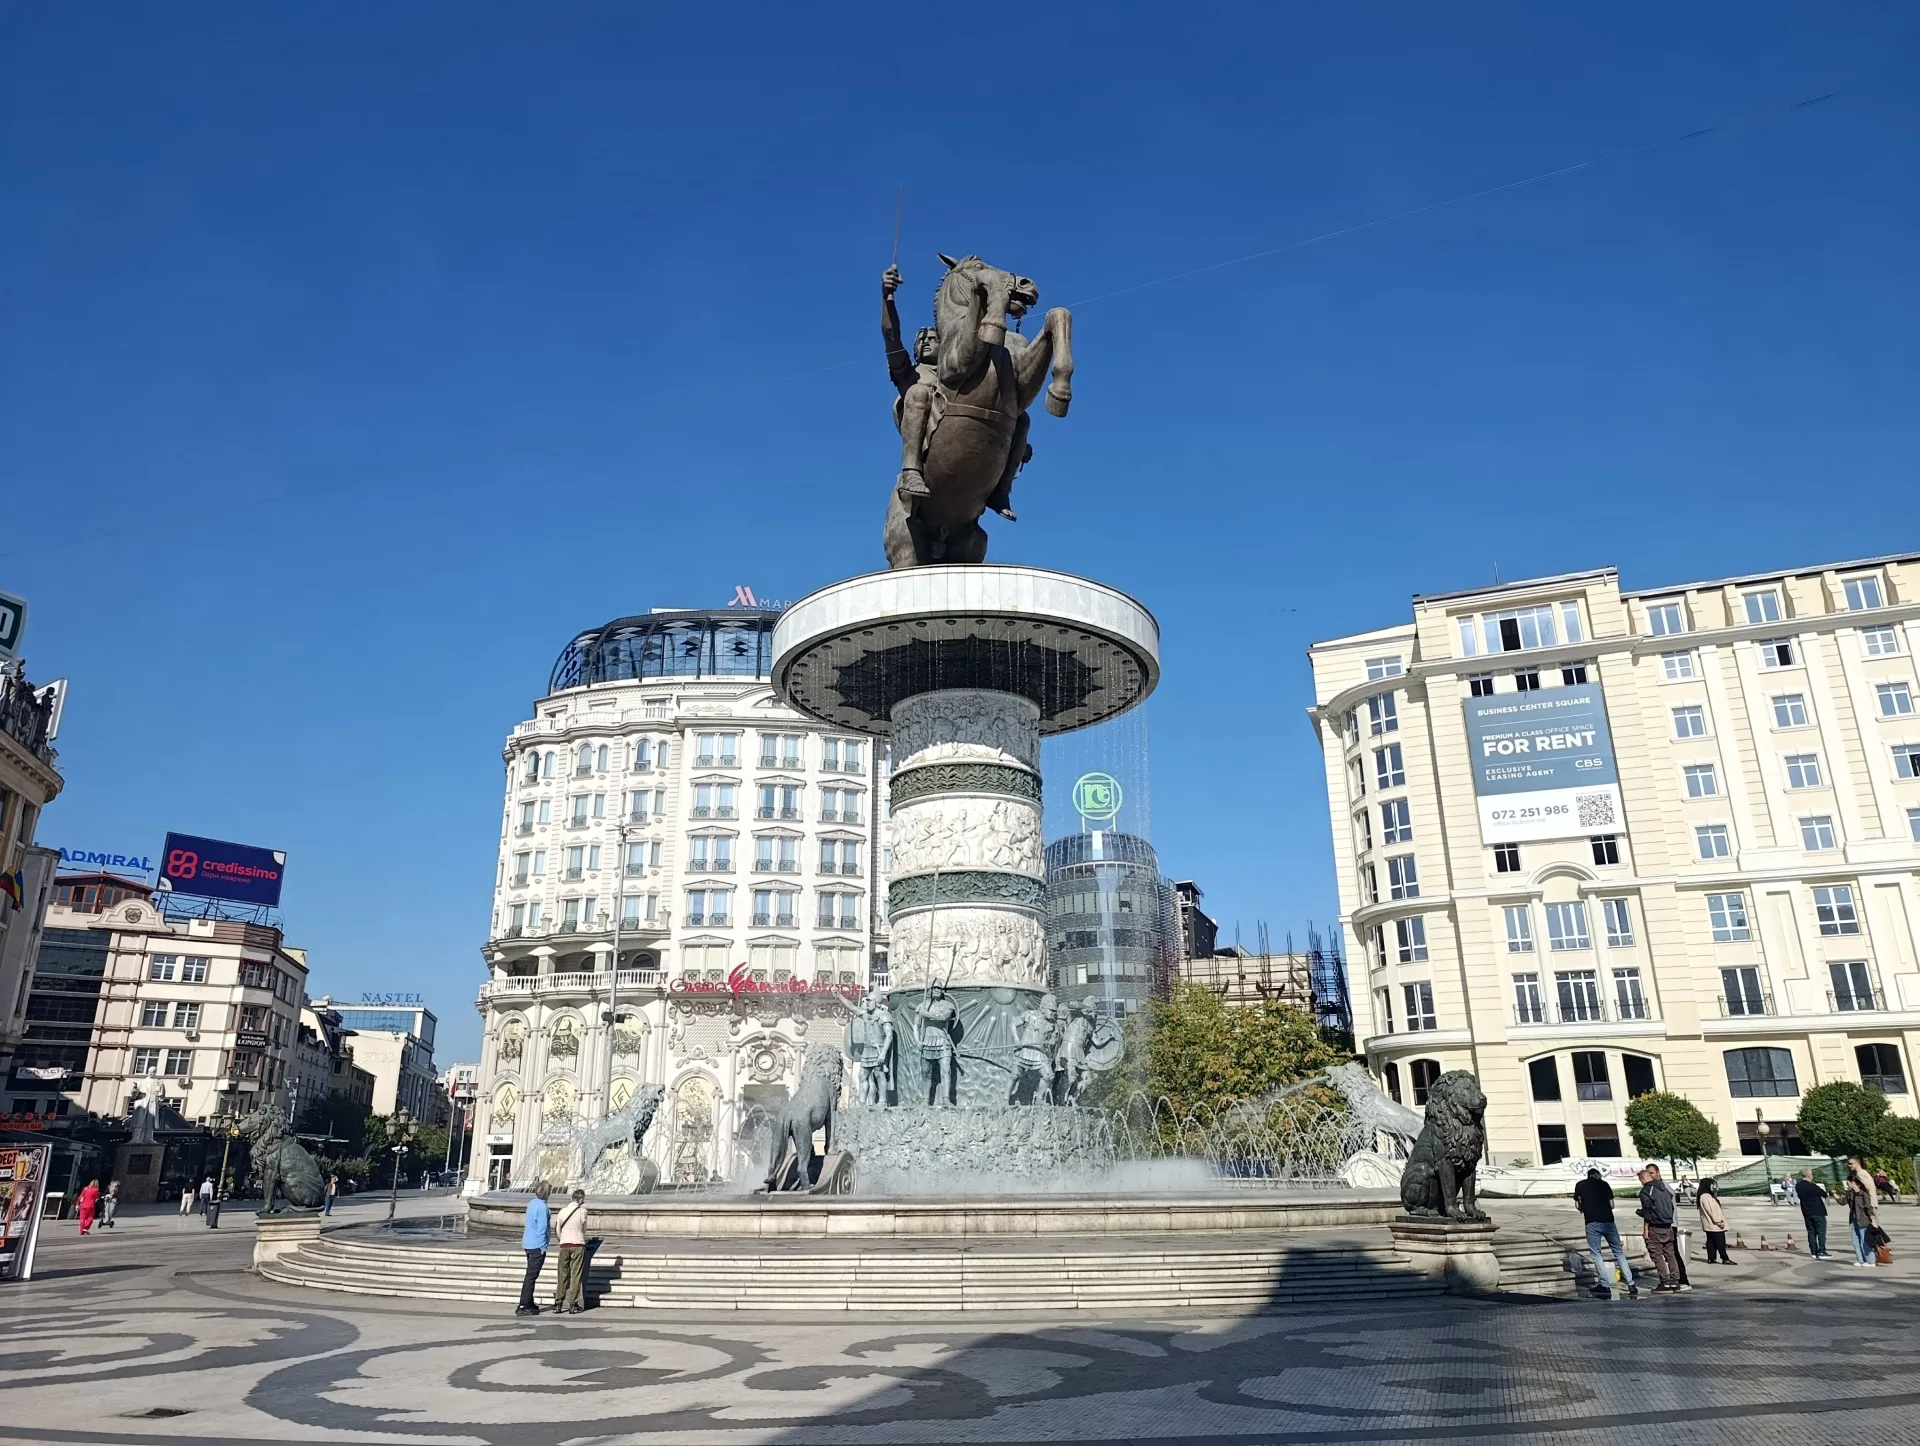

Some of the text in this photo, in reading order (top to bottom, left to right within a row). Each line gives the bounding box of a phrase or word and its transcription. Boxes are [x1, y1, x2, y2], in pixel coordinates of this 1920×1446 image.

[1477, 697, 1591, 716] BUSINESS CENTER SQUARE
[1482, 732, 1513, 741] PREMIUM
[1521, 729, 1543, 737] CLASS
[1545, 726, 1570, 734] OFFICE
[1571, 723, 1594, 731] SPACE
[1483, 730, 1596, 757] FOR RENT
[1485, 765, 1532, 775] EXCLUSIVE
[1575, 758, 1603, 768] CBS
[1486, 769, 1555, 781] LEASING AGENT
[1492, 804, 1569, 820] 072 251 986
[59, 847, 154, 871] ADMIRAL
[203, 861, 278, 880] credissimo
[362, 992, 424, 1003] NASTEL
